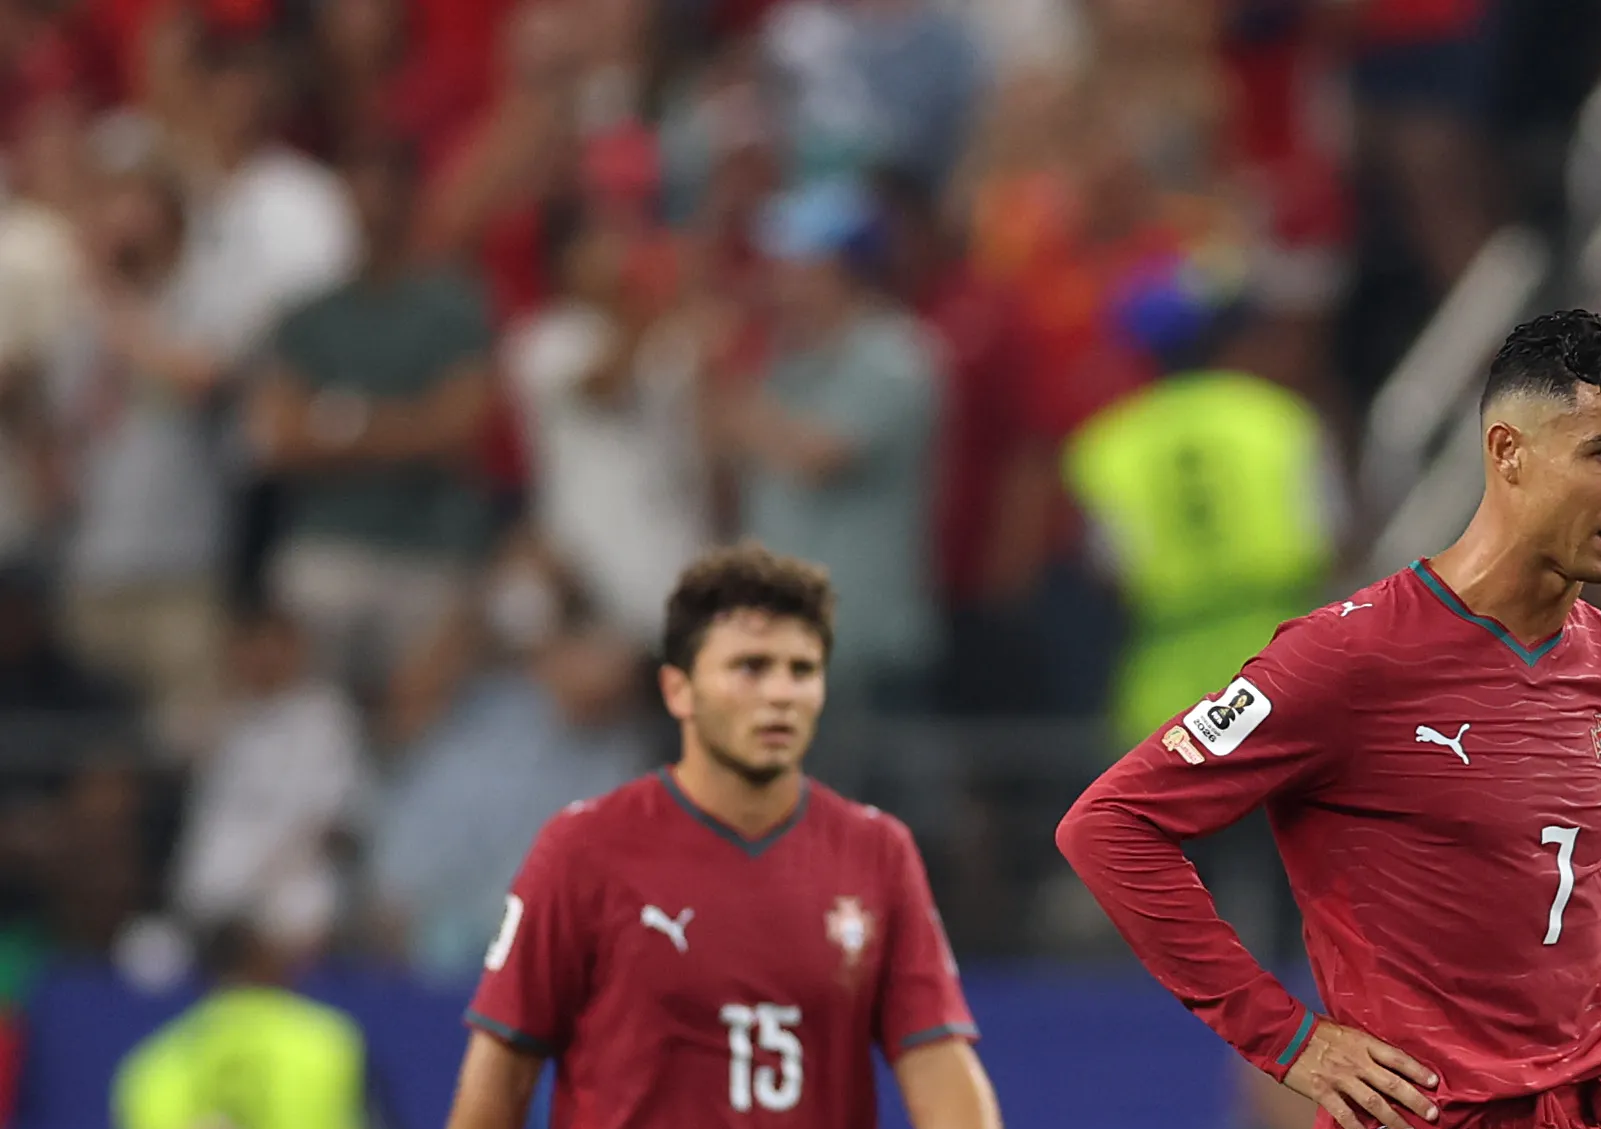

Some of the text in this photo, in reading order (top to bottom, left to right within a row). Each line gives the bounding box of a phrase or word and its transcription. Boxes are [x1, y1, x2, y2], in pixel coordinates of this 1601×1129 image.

[1193, 718, 1217, 743] 2026
[1541, 825, 1580, 945] 7
[719, 1002, 803, 1112] 15
